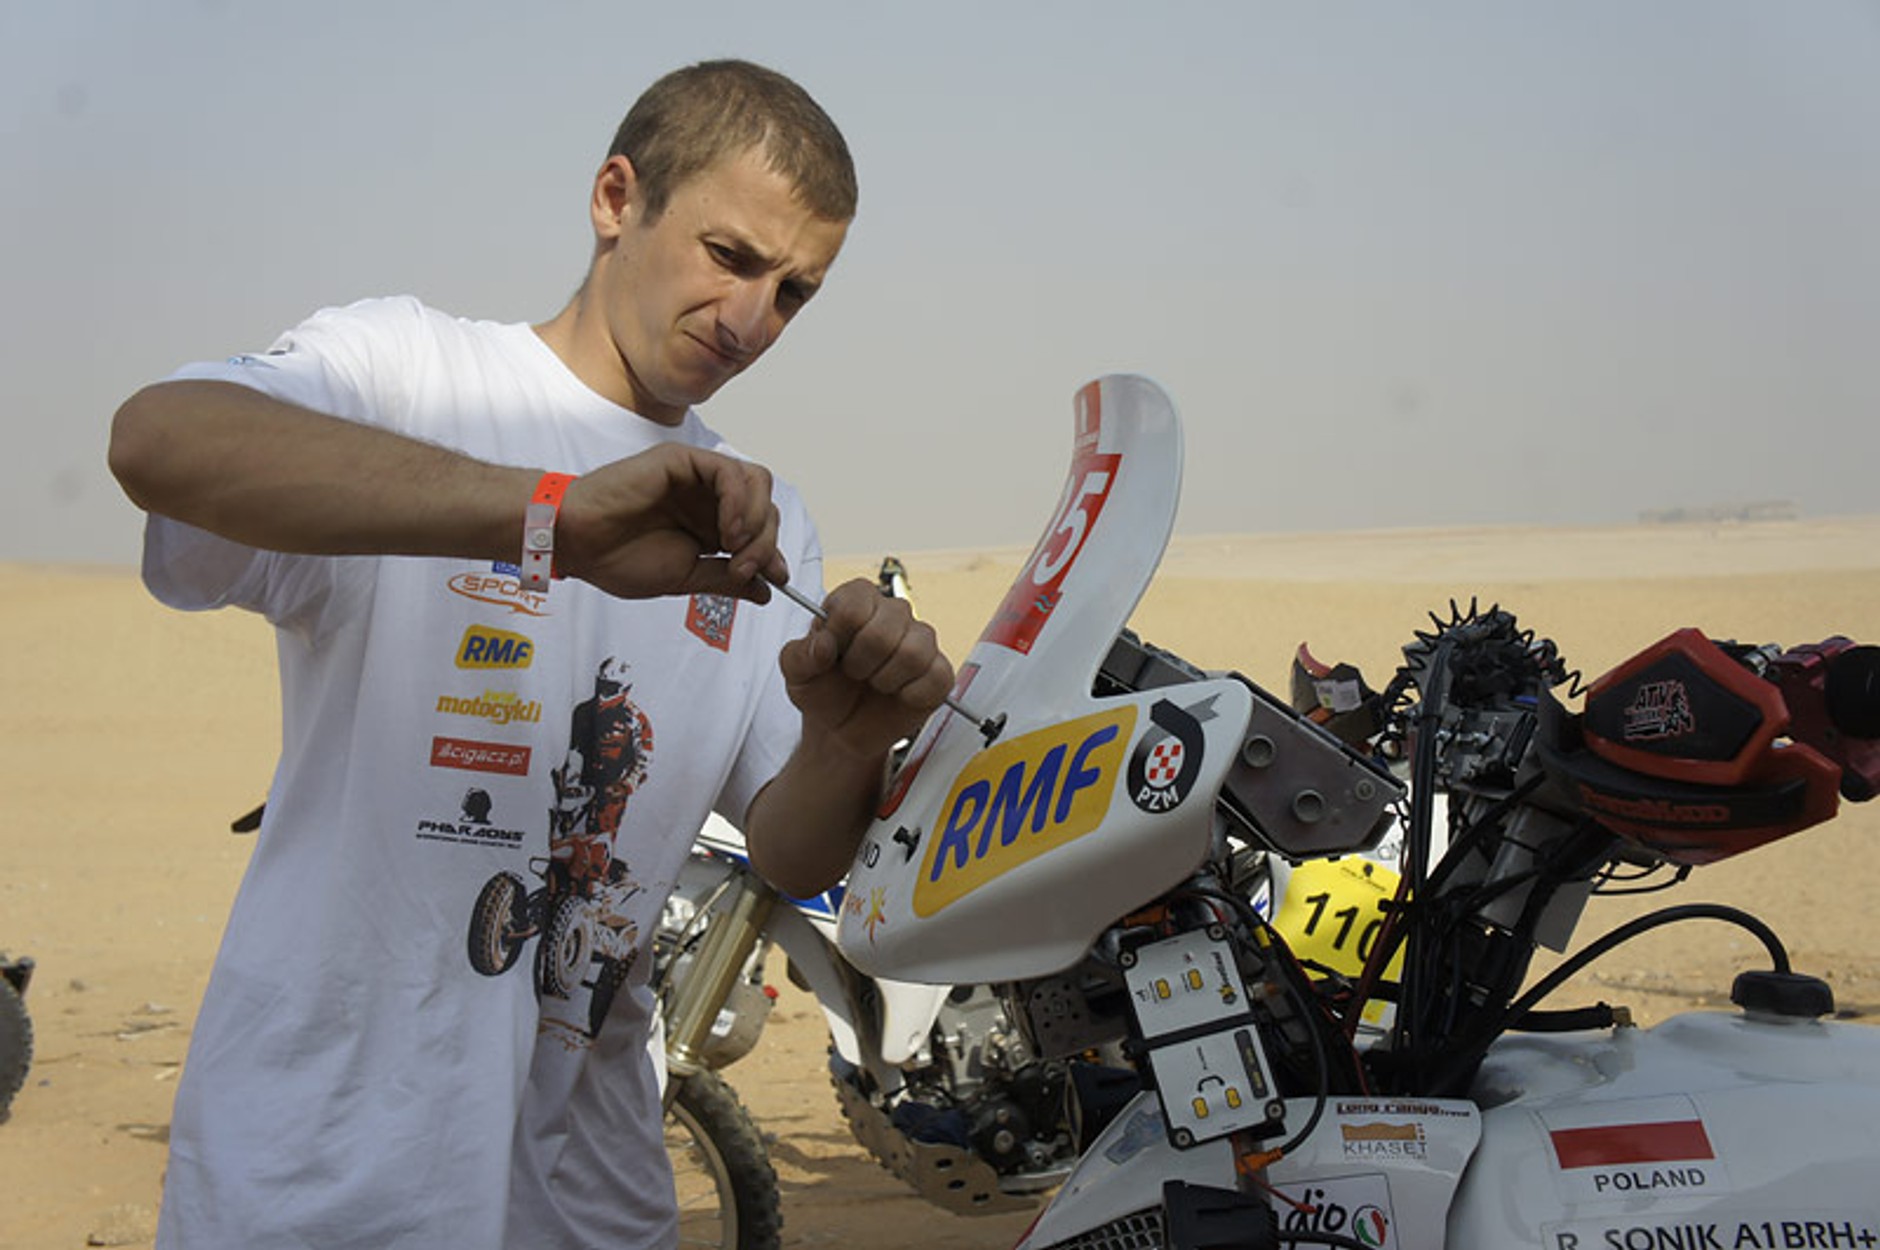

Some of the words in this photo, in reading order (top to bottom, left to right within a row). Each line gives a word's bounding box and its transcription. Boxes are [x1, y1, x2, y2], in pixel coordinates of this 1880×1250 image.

[463, 635, 532, 665] RMF
[930, 724, 1120, 883] RMF
[1136, 785, 1180, 809] PZM
[1342, 1141, 1427, 1155] KHASET
[1594, 1168, 1706, 1193] POLAND
[1604, 1224, 1721, 1250] SONIK
